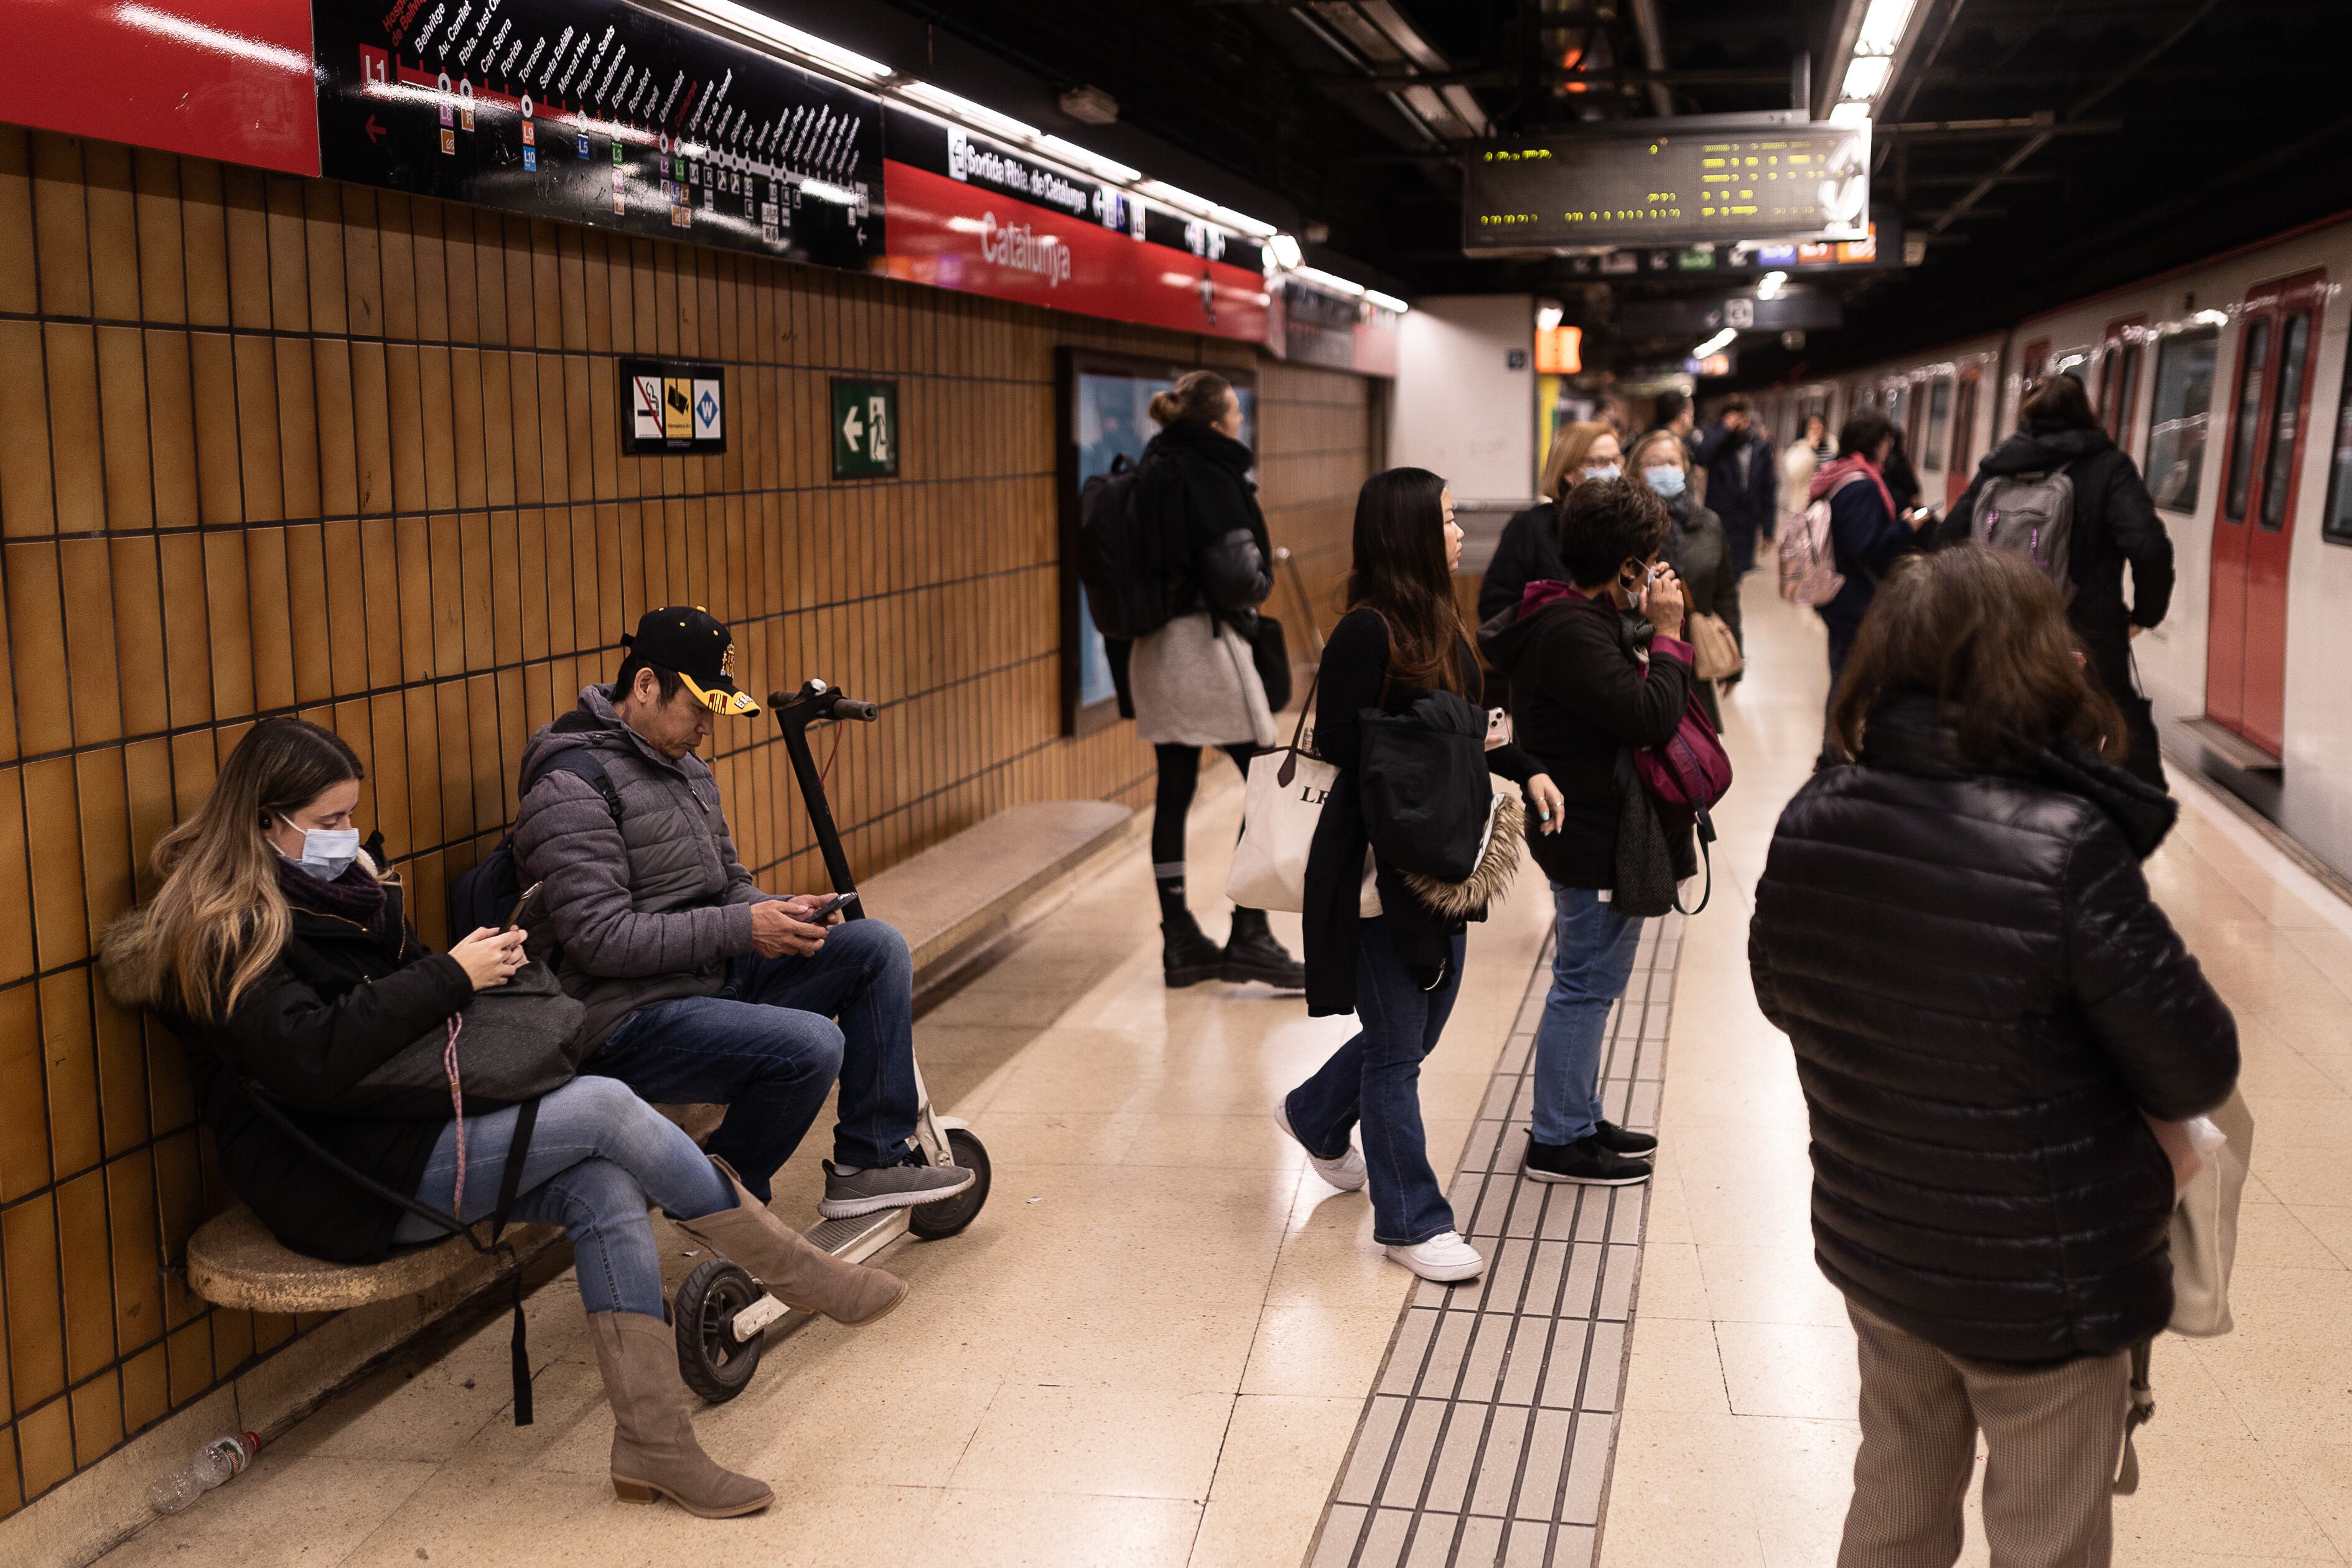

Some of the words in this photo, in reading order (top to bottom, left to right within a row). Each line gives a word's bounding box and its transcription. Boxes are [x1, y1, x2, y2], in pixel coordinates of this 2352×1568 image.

[392, 29, 403, 46] de
[414, 3, 446, 54] Bellvitge
[438, 41, 450, 60] Av.
[447, 0, 472, 42] Carrilet
[459, 37, 478, 66] Rbla.
[476, 7, 492, 37] Just
[480, 51, 496, 73] Can
[493, 18, 511, 50] Serra
[365, 55, 385, 85] L1
[500, 39, 523, 78] Florida
[518, 36, 546, 83] Torrassa
[539, 58, 558, 90] Santa
[554, 26, 574, 62] Eulàlia
[558, 53, 580, 94] Mercat
[576, 32, 591, 58] Nou
[576, 68, 594, 100] Plaça
[592, 53, 600, 70] de
[598, 25, 615, 56] Sants
[595, 44, 626, 105] Hostafrancs
[611, 65, 635, 110] Espanya
[628, 67, 651, 114] Rocafort
[643, 85, 660, 119] Urgell
[659, 70, 684, 123] Universitat
[524, 125, 534, 140] L9
[579, 139, 588, 154] L5
[612, 147, 622, 162] L3
[524, 150, 535, 163] L10
[660, 158, 669, 172] L2
[967, 144, 1005, 184] Sortida
[1030, 168, 1044, 197] de
[1043, 172, 1087, 215] Catalunya
[980, 210, 1071, 289] Catalunya
[701, 401, 713, 419] W
